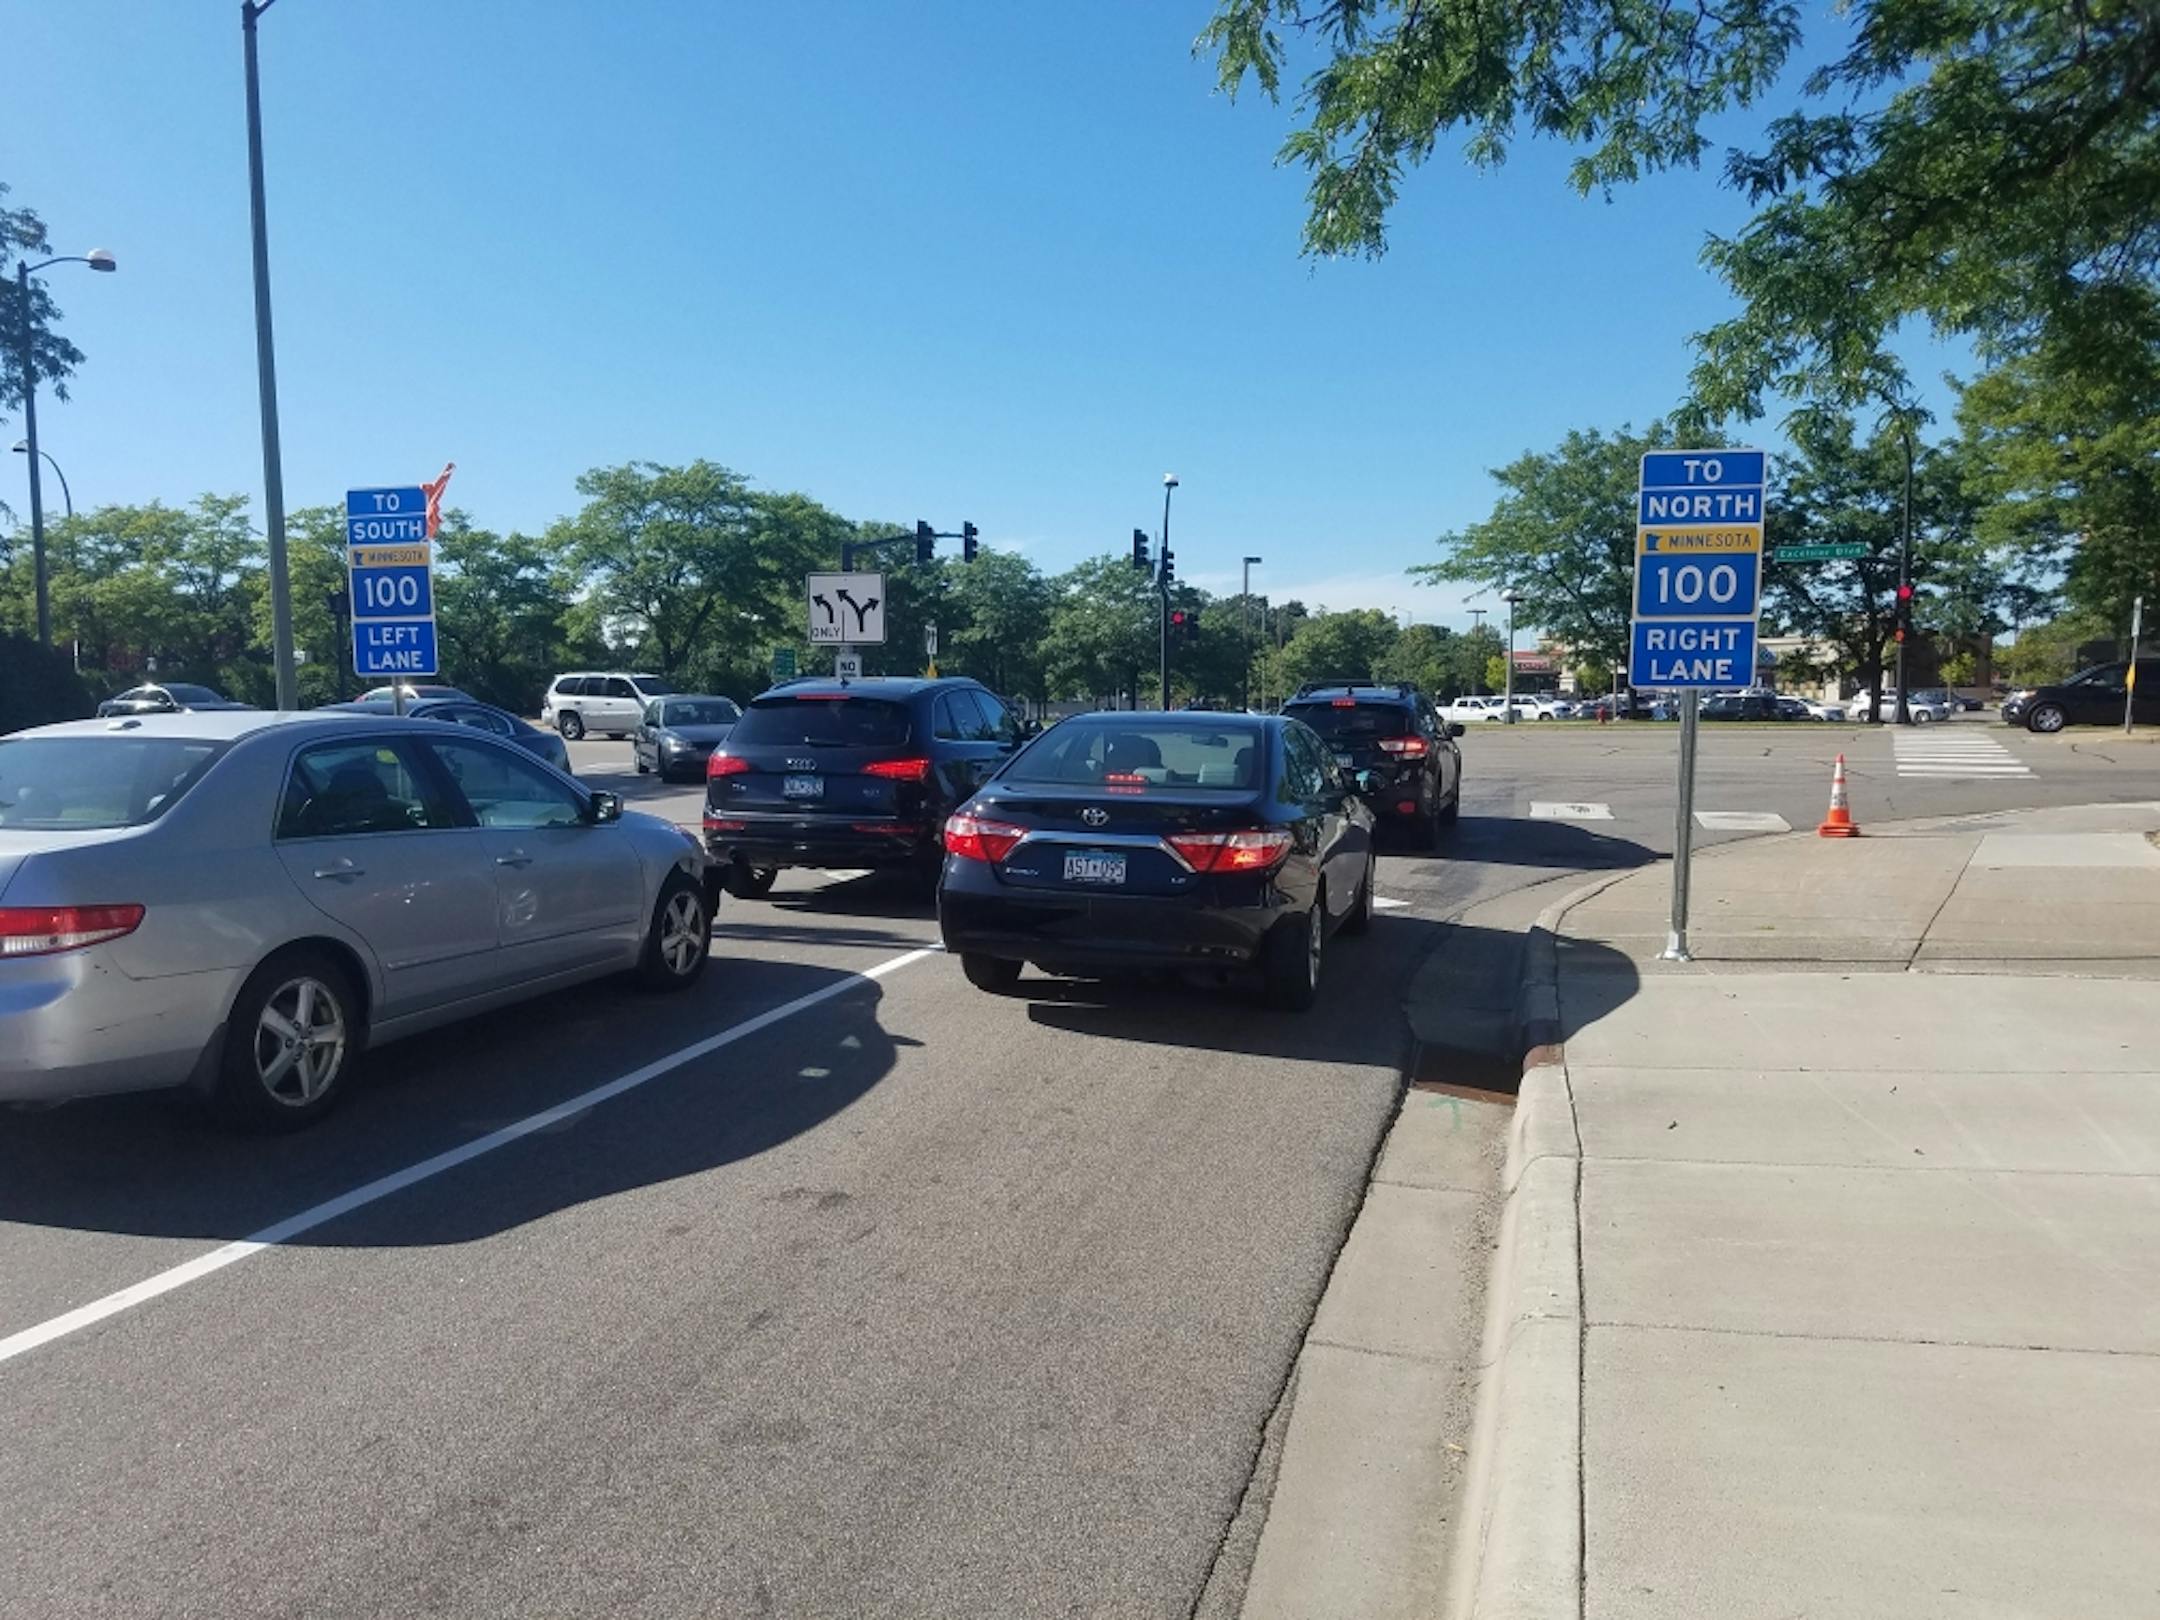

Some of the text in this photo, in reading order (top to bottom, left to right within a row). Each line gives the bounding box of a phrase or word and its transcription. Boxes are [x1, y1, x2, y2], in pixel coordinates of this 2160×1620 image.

[1683, 459, 1723, 483] TO
[373, 493, 400, 512] TO
[1648, 494, 1755, 518] NORTH
[353, 520, 423, 541] SOUTH
[1669, 533, 1751, 548] MINNESOTA
[368, 550, 423, 563] MINNESOTA
[364, 575, 418, 608] 100
[1658, 565, 1737, 604] 100
[368, 626, 419, 646] LEFT
[812, 627, 840, 638] ONLY
[1647, 628, 1741, 651] RIGHT
[368, 650, 424, 670] LANE
[840, 661, 856, 672] NO
[1651, 659, 1732, 680] LANE
